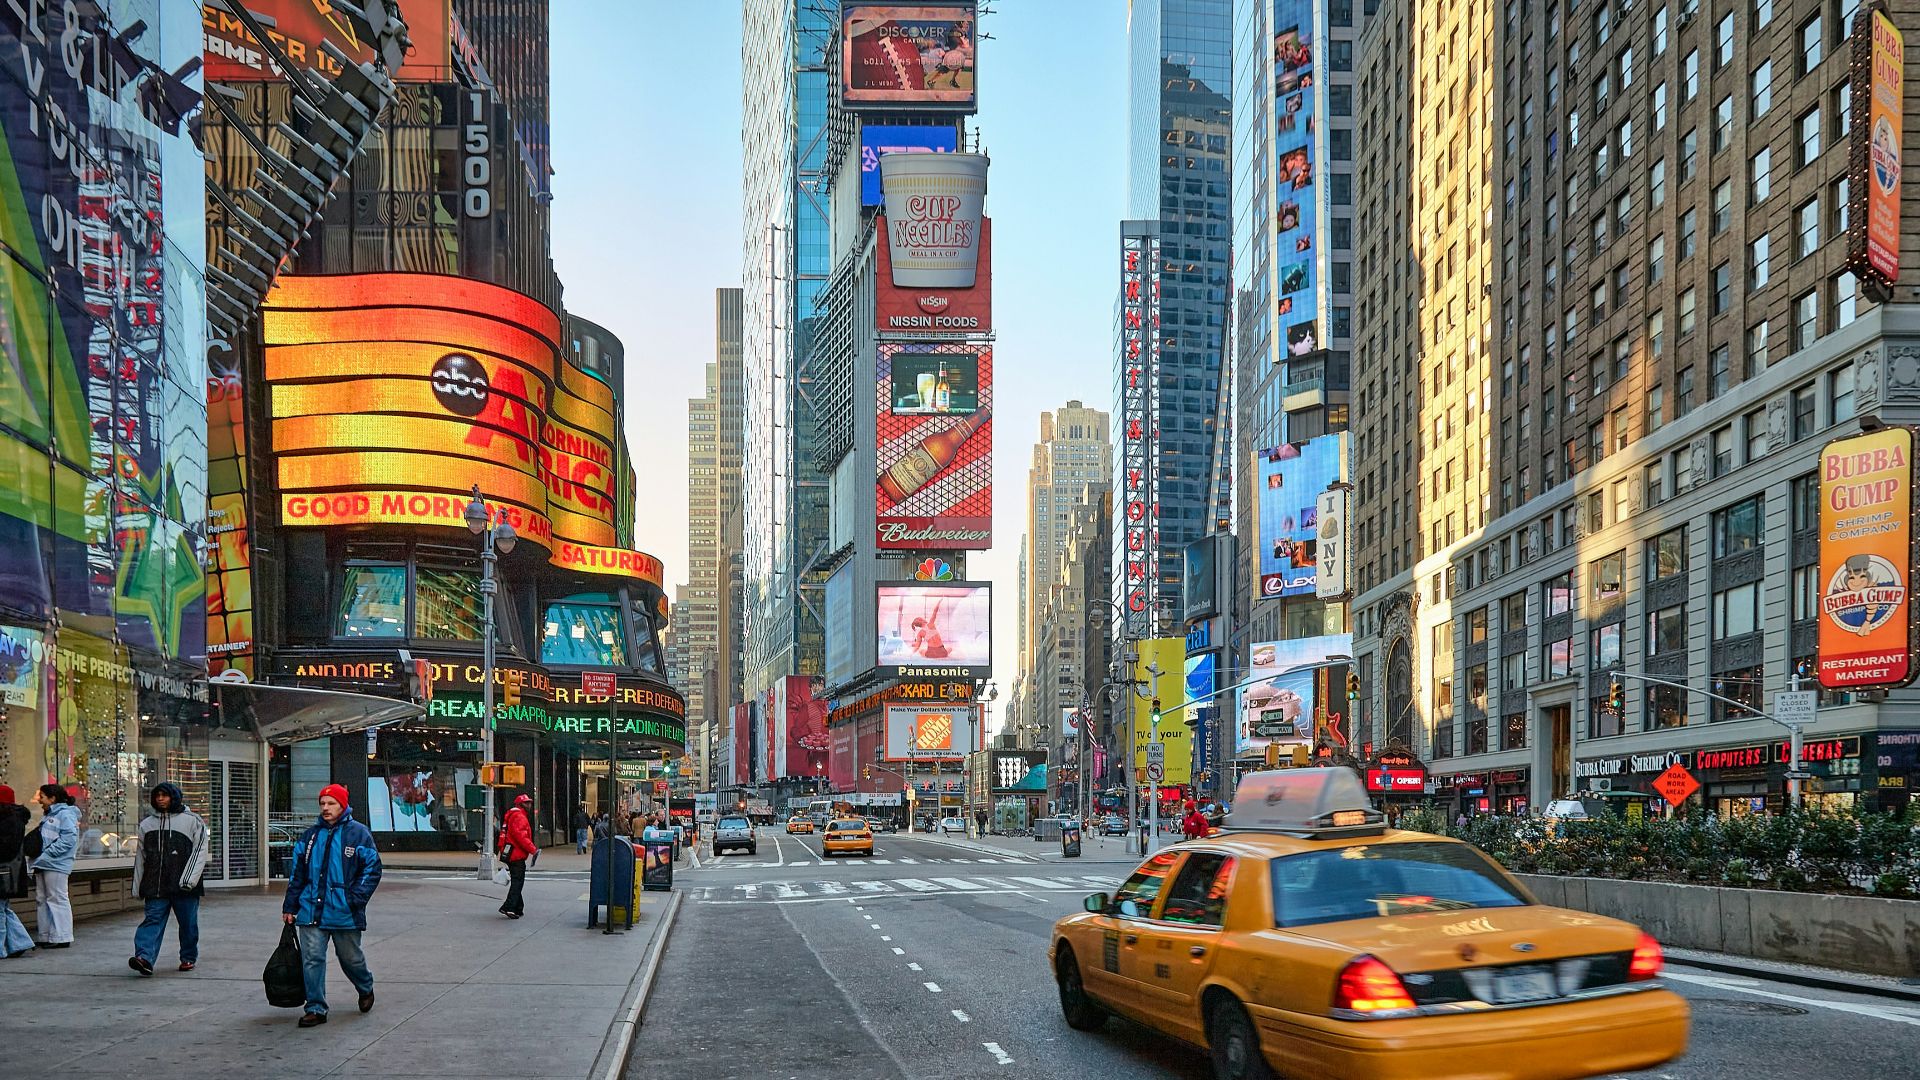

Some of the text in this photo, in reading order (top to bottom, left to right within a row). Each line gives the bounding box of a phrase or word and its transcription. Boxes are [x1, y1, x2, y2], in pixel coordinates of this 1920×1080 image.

[879, 26, 945, 37] DISCOVER
[1874, 15, 1902, 66] BUBBA
[1876, 50, 1900, 92] GUMP
[465, 93, 490, 218] 1500
[906, 195, 960, 221] CUP
[894, 219, 974, 248] NOODLES
[921, 296, 948, 307] NISSIN
[890, 317, 978, 328] NISSIN FOODS
[432, 368, 487, 400] abc
[541, 420, 608, 466] ORNING
[1826, 445, 1905, 481] BUBBA
[1326, 496, 1335, 514] I
[1831, 478, 1900, 512] GUMP
[287, 495, 370, 518] GOOD
[382, 494, 522, 529] MORNNG
[1836, 512, 1893, 529] SHRIMP
[208, 524, 234, 533] Rejects
[878, 522, 990, 542] Budweiser
[1829, 521, 1901, 541] COMPANY
[1827, 588, 1902, 612] BUBBA GUMP
[1838, 605, 1866, 617] SHRIMP
[296, 664, 337, 677] AND
[898, 667, 970, 677] Panasonic
[1822, 654, 1904, 669] RESTAURANT
[89, 657, 135, 685] PERFECT
[139, 671, 157, 691] TOY
[1835, 668, 1890, 681] MARKET
[554, 717, 591, 733] ARE
[597, 717, 660, 736] READING
[917, 714, 952, 749] HOME
[920, 717, 935, 732] THE
[1137, 731, 1145, 739] TV
[1161, 731, 1183, 740] your
[930, 726, 952, 749] DEPOT
[1697, 747, 1761, 770] COMPUTERS
[1781, 741, 1842, 763] CMERAS
[1576, 761, 1598, 777] BUBBA
[1600, 759, 1621, 776] GUMP
[1631, 752, 1663, 772] SHRIMP
